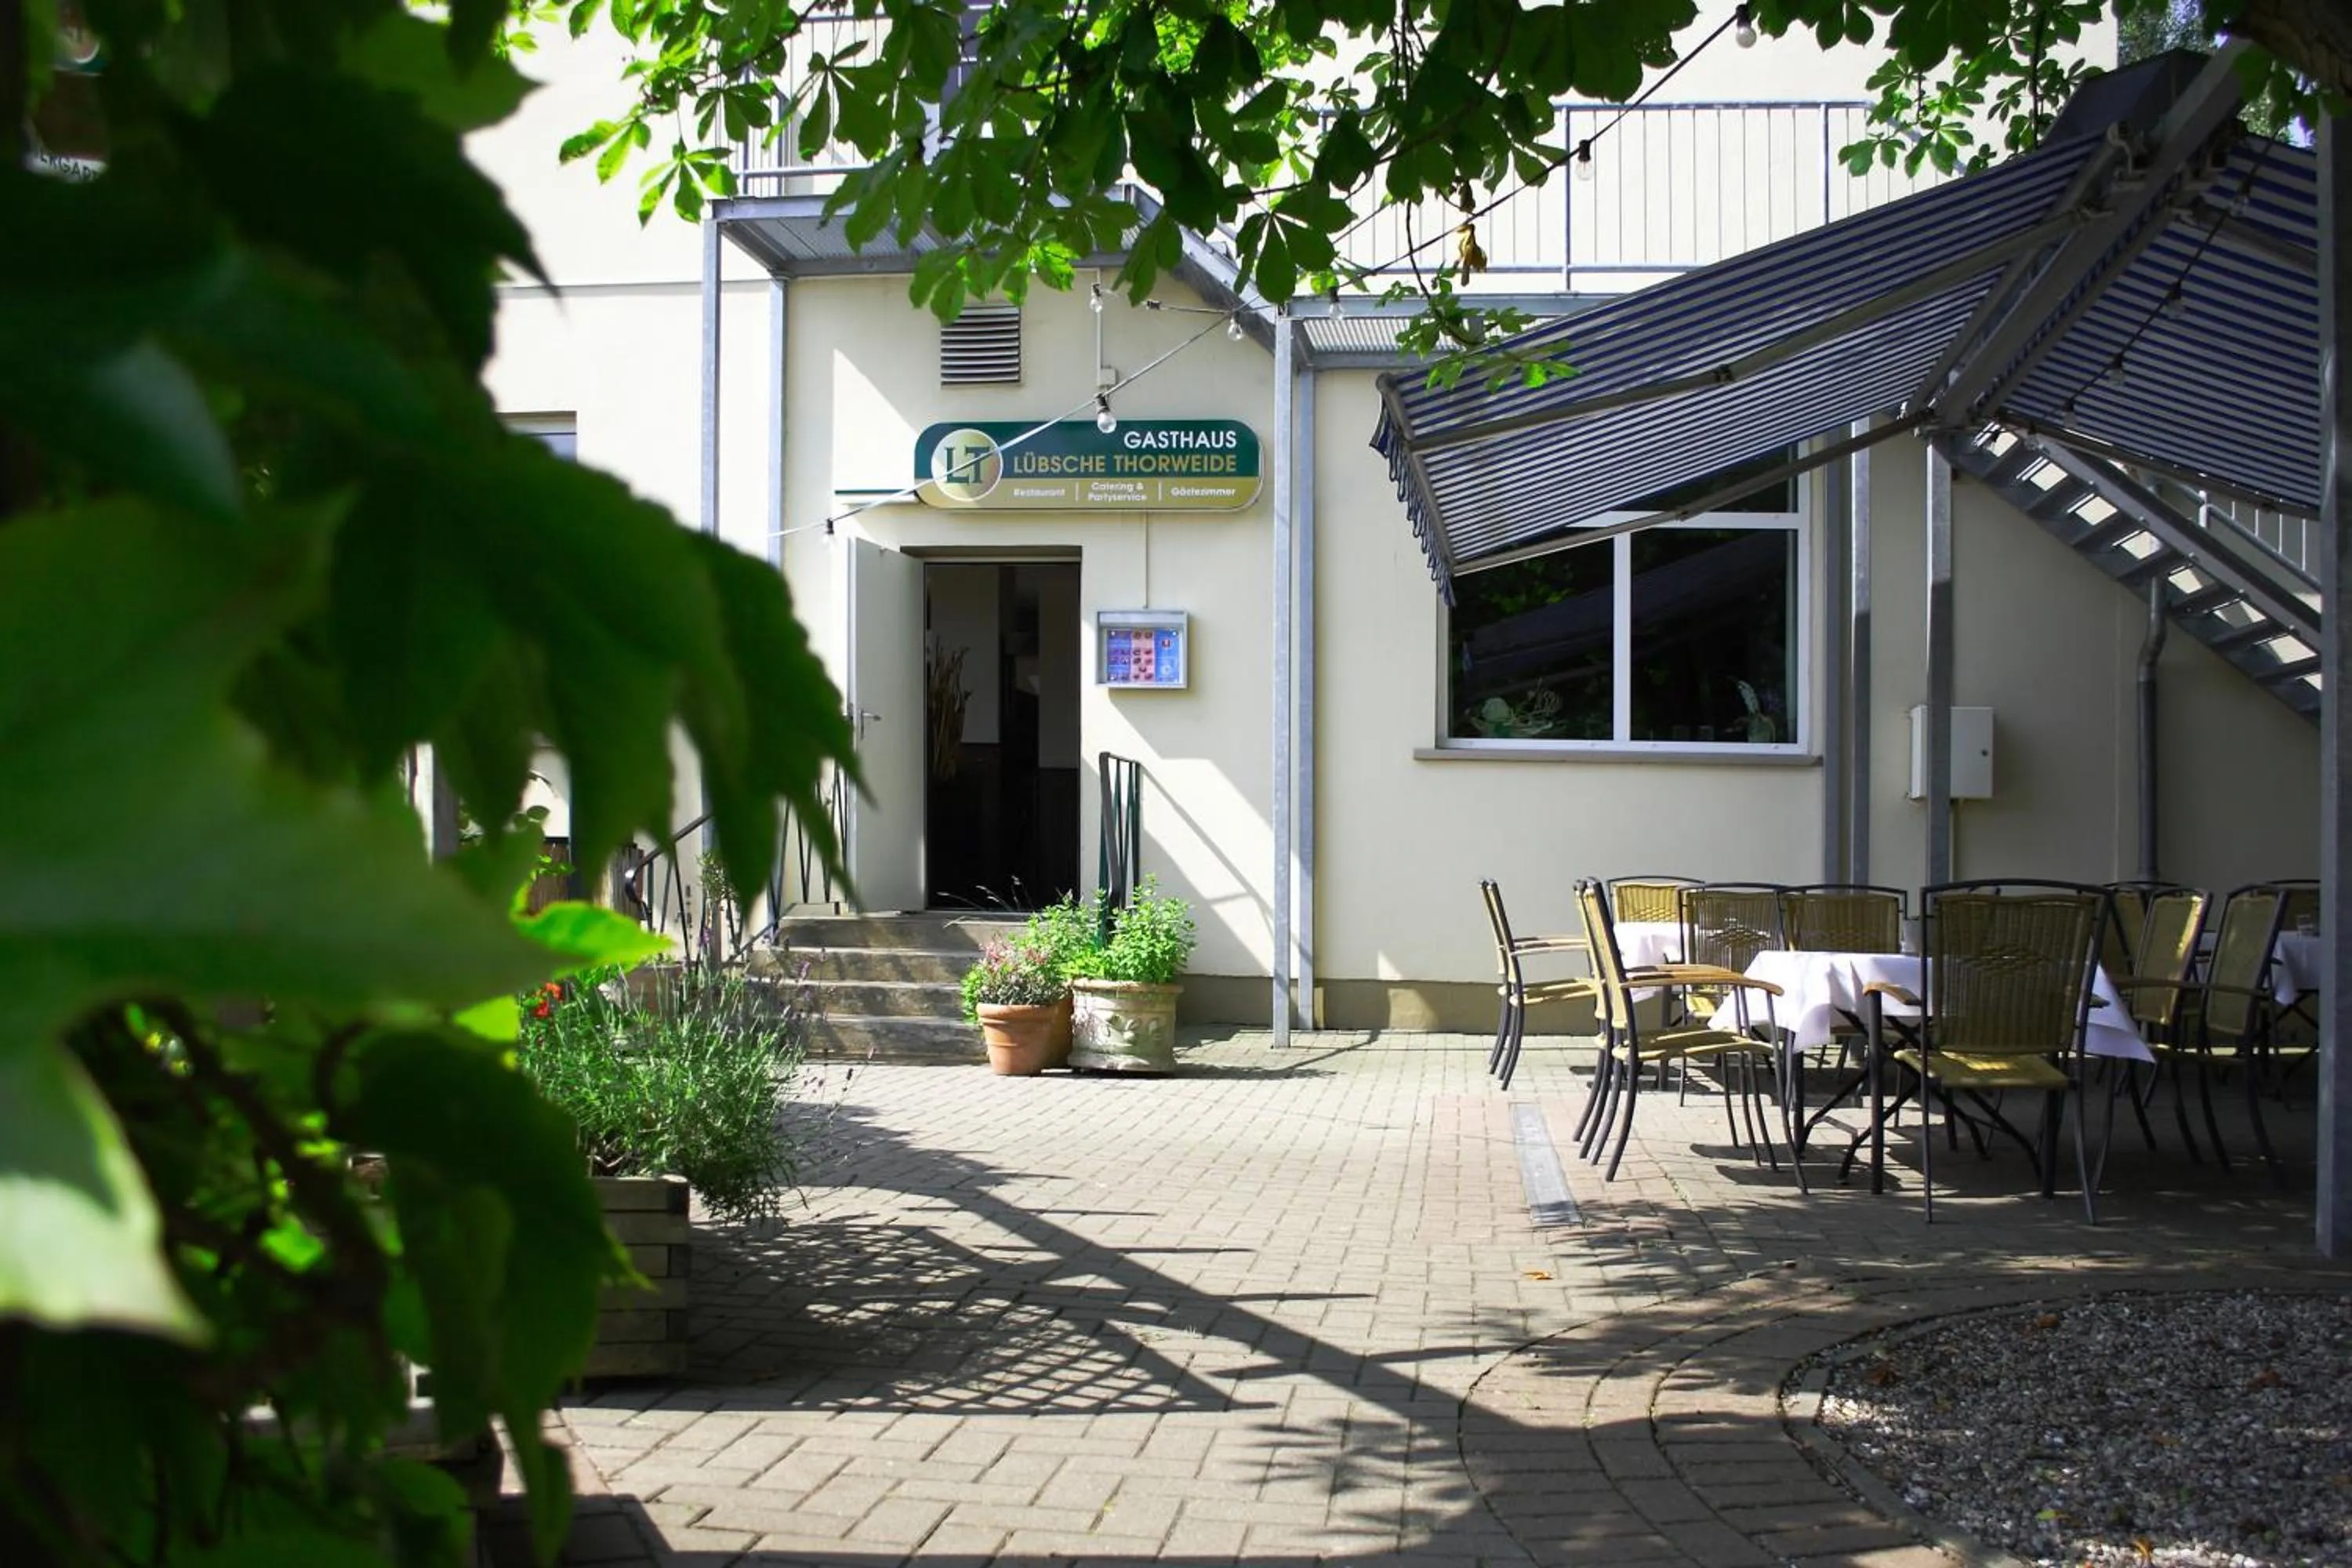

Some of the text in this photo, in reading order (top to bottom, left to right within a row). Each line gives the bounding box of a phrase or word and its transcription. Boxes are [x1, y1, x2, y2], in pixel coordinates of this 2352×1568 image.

[1123, 430, 1237, 449] GASTHAUS
[1014, 452, 1237, 474] LÜBSCHE THORWEIDE
[1091, 481, 1134, 493] Catering
[1171, 486, 1236, 496] Gästezimmer
[1087, 492, 1148, 503] Partyservice
